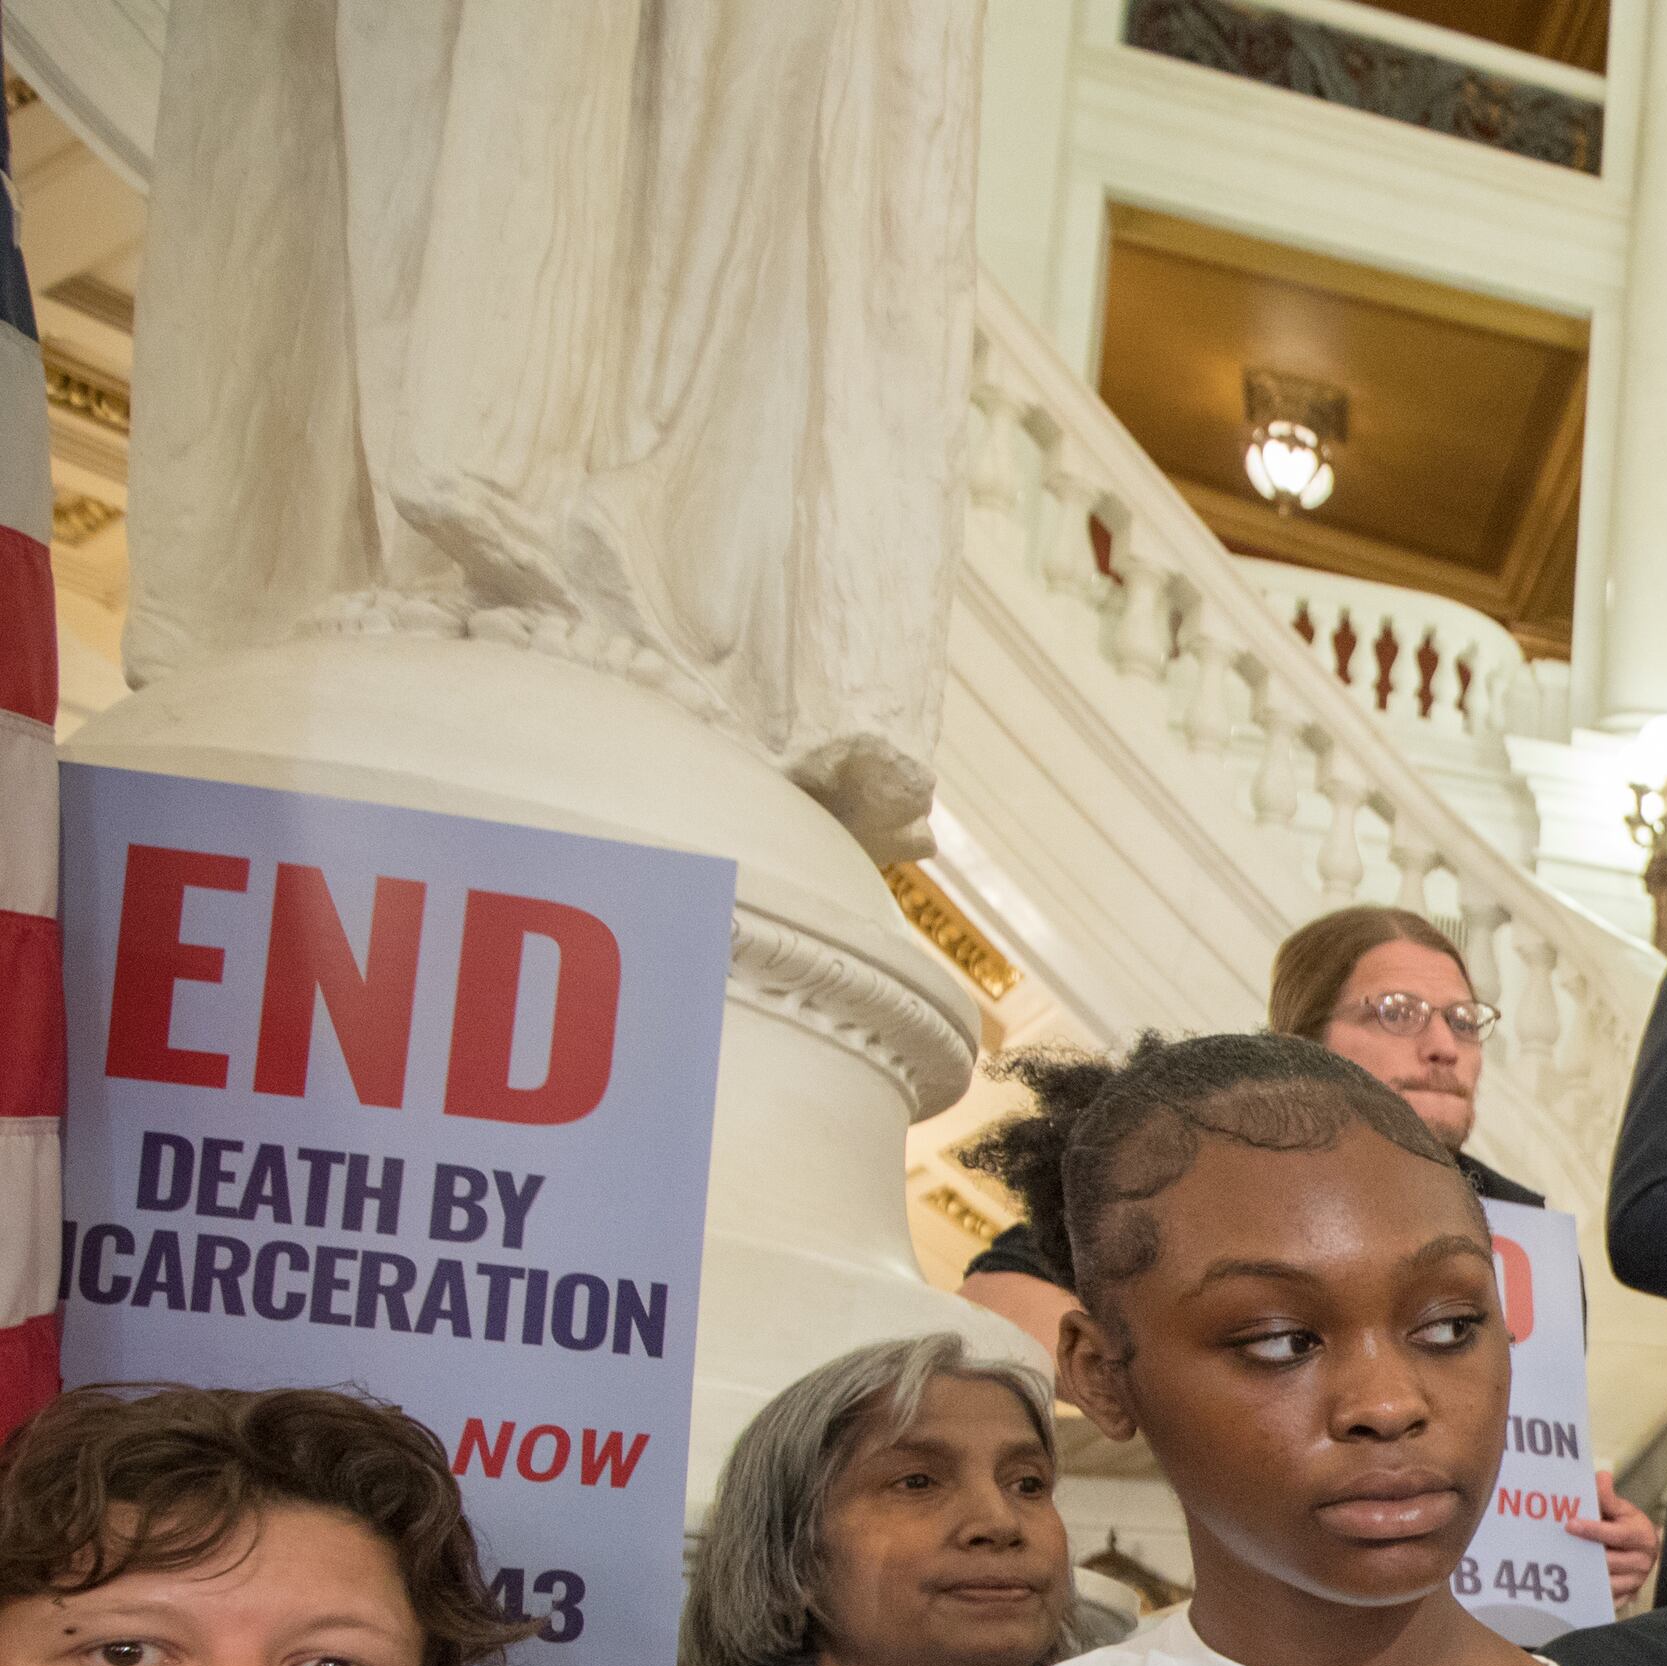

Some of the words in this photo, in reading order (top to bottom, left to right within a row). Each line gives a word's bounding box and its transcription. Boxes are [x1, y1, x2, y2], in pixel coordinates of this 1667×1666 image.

[105, 844, 622, 1127] END
[136, 1131, 405, 1237] DEATH
[428, 1163, 545, 1250] BY
[58, 1219, 670, 1359] CARCERATION
[452, 1417, 650, 1489] NOW
[1497, 1487, 1581, 1523] NOW
[491, 1567, 586, 1643] 43
[1453, 1555, 1482, 1596] B
[1494, 1558, 1570, 1603] 443
